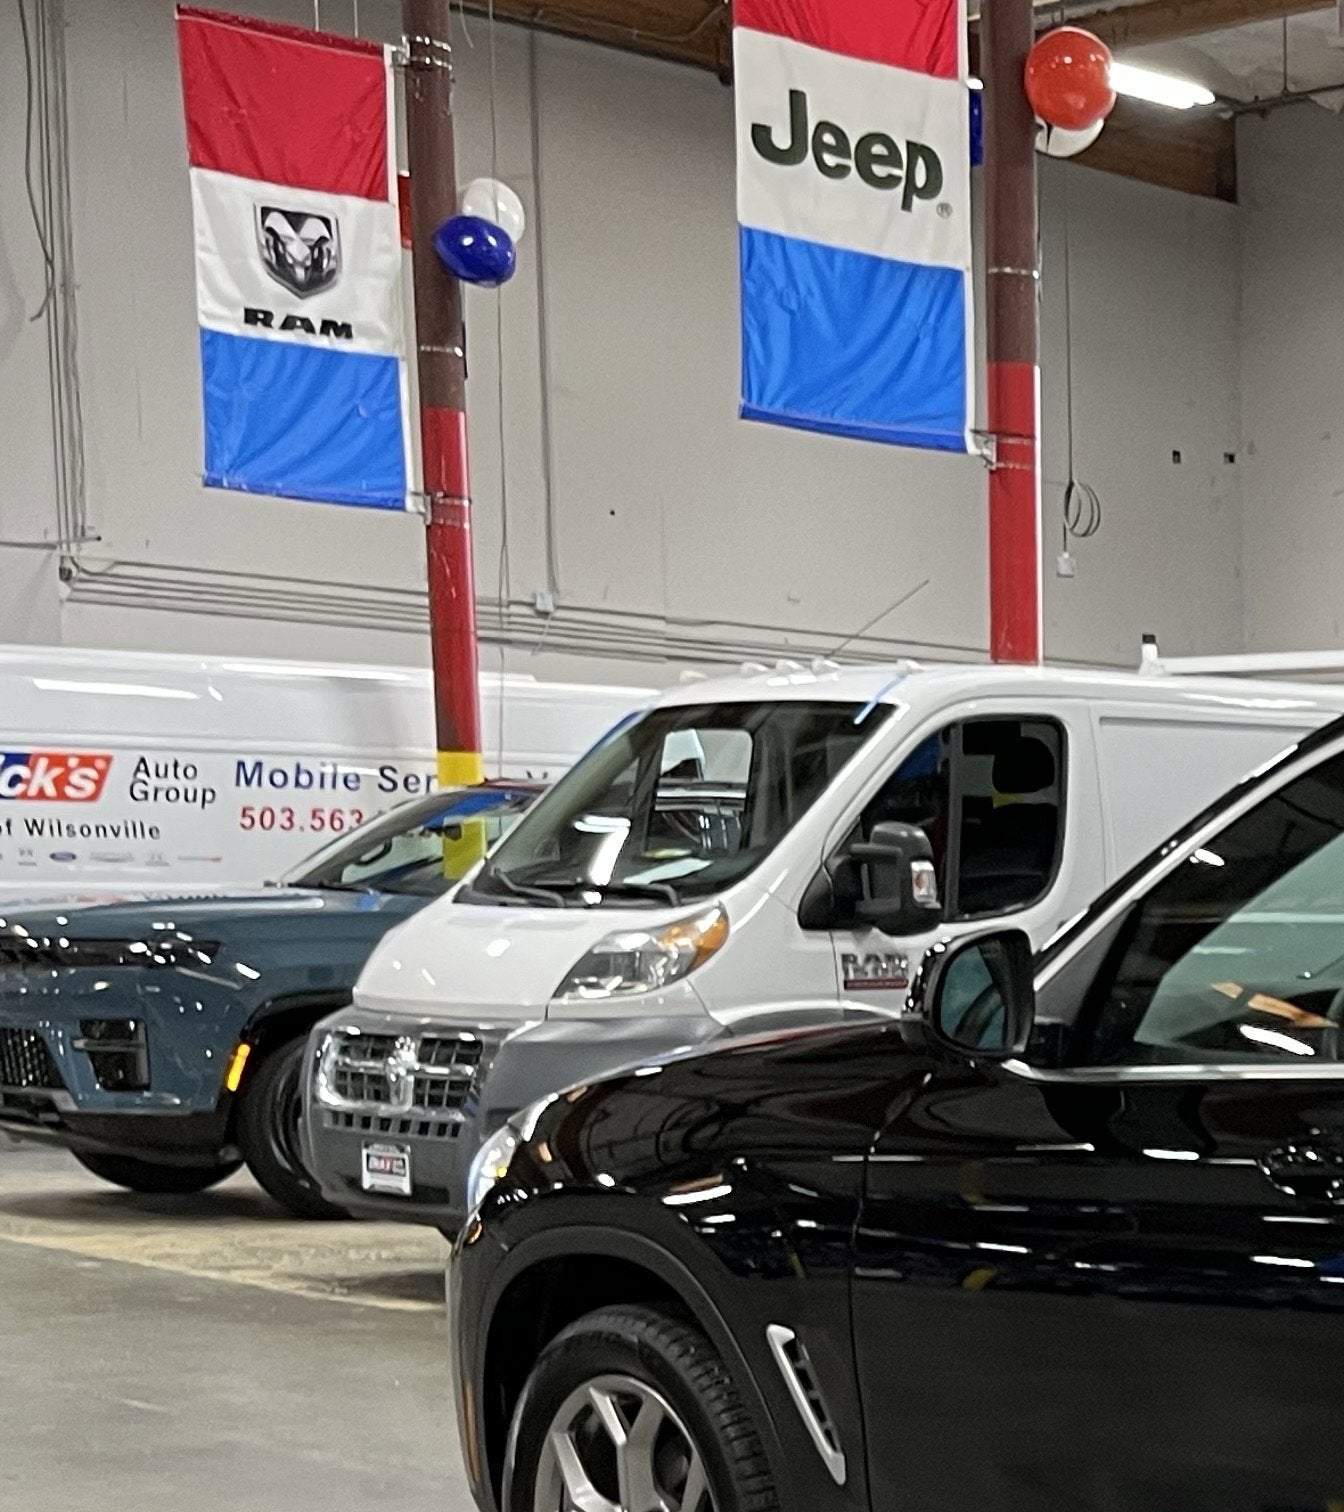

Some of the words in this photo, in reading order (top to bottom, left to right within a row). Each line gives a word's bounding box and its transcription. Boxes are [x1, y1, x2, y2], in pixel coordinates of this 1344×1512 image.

[751, 89, 943, 213] Jeep
[244, 307, 353, 339] RAM
[132, 756, 198, 780] Auto
[235, 760, 361, 791] Mobile
[129, 780, 217, 809] Group
[24, 818, 160, 839] Wilsonville
